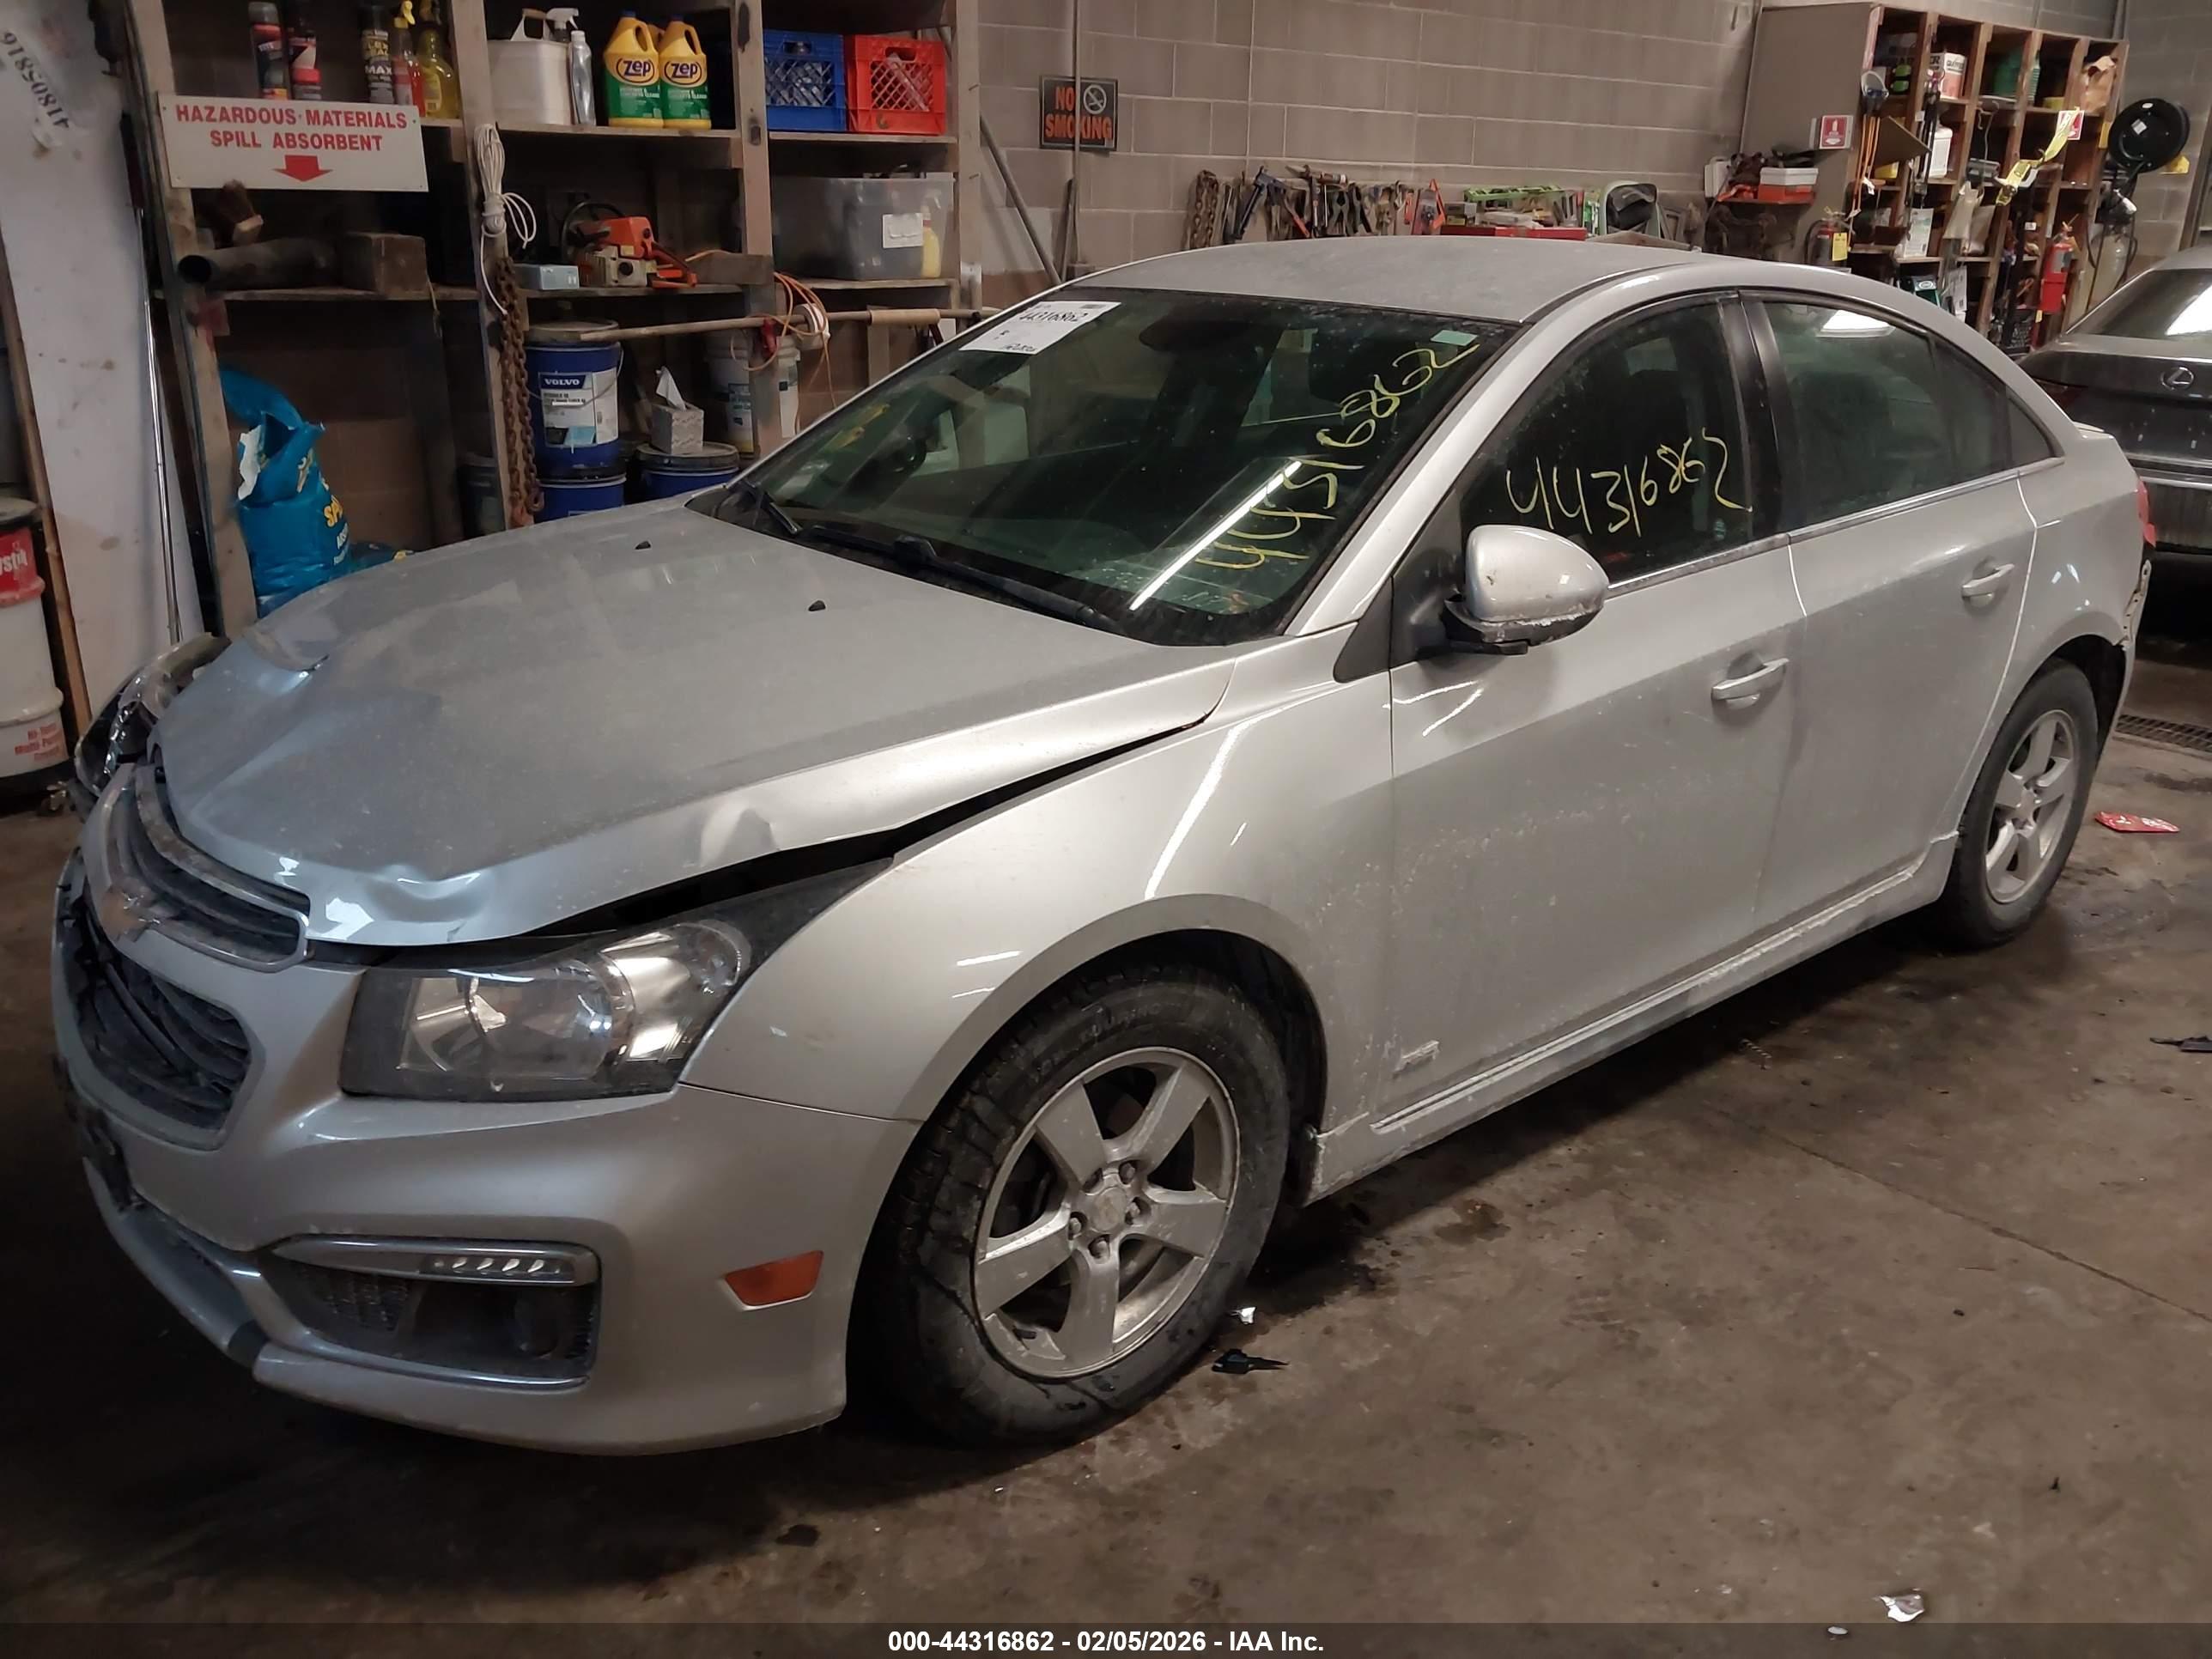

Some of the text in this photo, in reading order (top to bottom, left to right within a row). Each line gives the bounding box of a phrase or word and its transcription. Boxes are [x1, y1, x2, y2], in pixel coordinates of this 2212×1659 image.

[1055, 86, 1075, 112] NO
[176, 105, 408, 130] HAZARDOUS MATERIALS
[210, 130, 383, 152] SPILL ABSORBENT
[1505, 427, 1753, 538] 44316862
